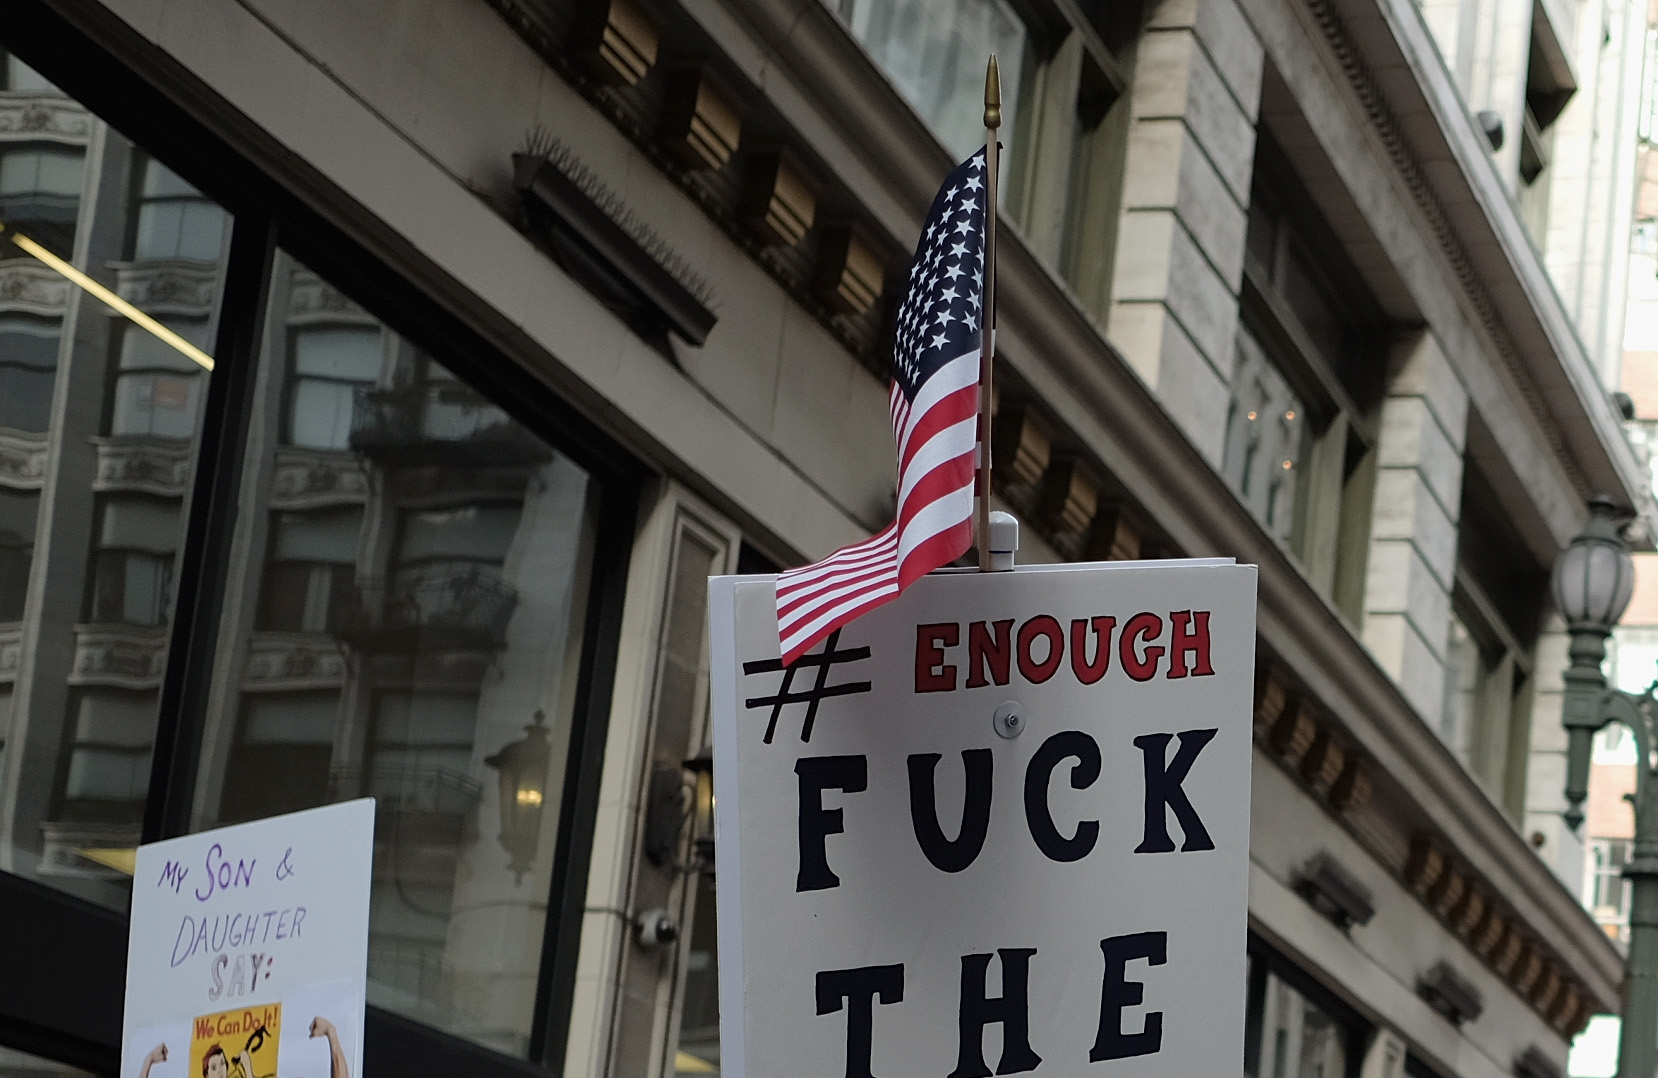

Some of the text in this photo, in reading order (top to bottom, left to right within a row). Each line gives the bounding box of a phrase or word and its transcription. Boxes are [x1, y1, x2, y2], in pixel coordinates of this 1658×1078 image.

[914, 609, 1216, 694] ENOUGH
[793, 728, 1219, 893] FUCK
[195, 843, 256, 901] SON
[276, 847, 294, 881] &
[170, 906, 307, 968] DAUGHTER
[208, 952, 273, 1001] SAY:
[196, 1018, 215, 1040] We
[216, 1016, 240, 1035] Can
